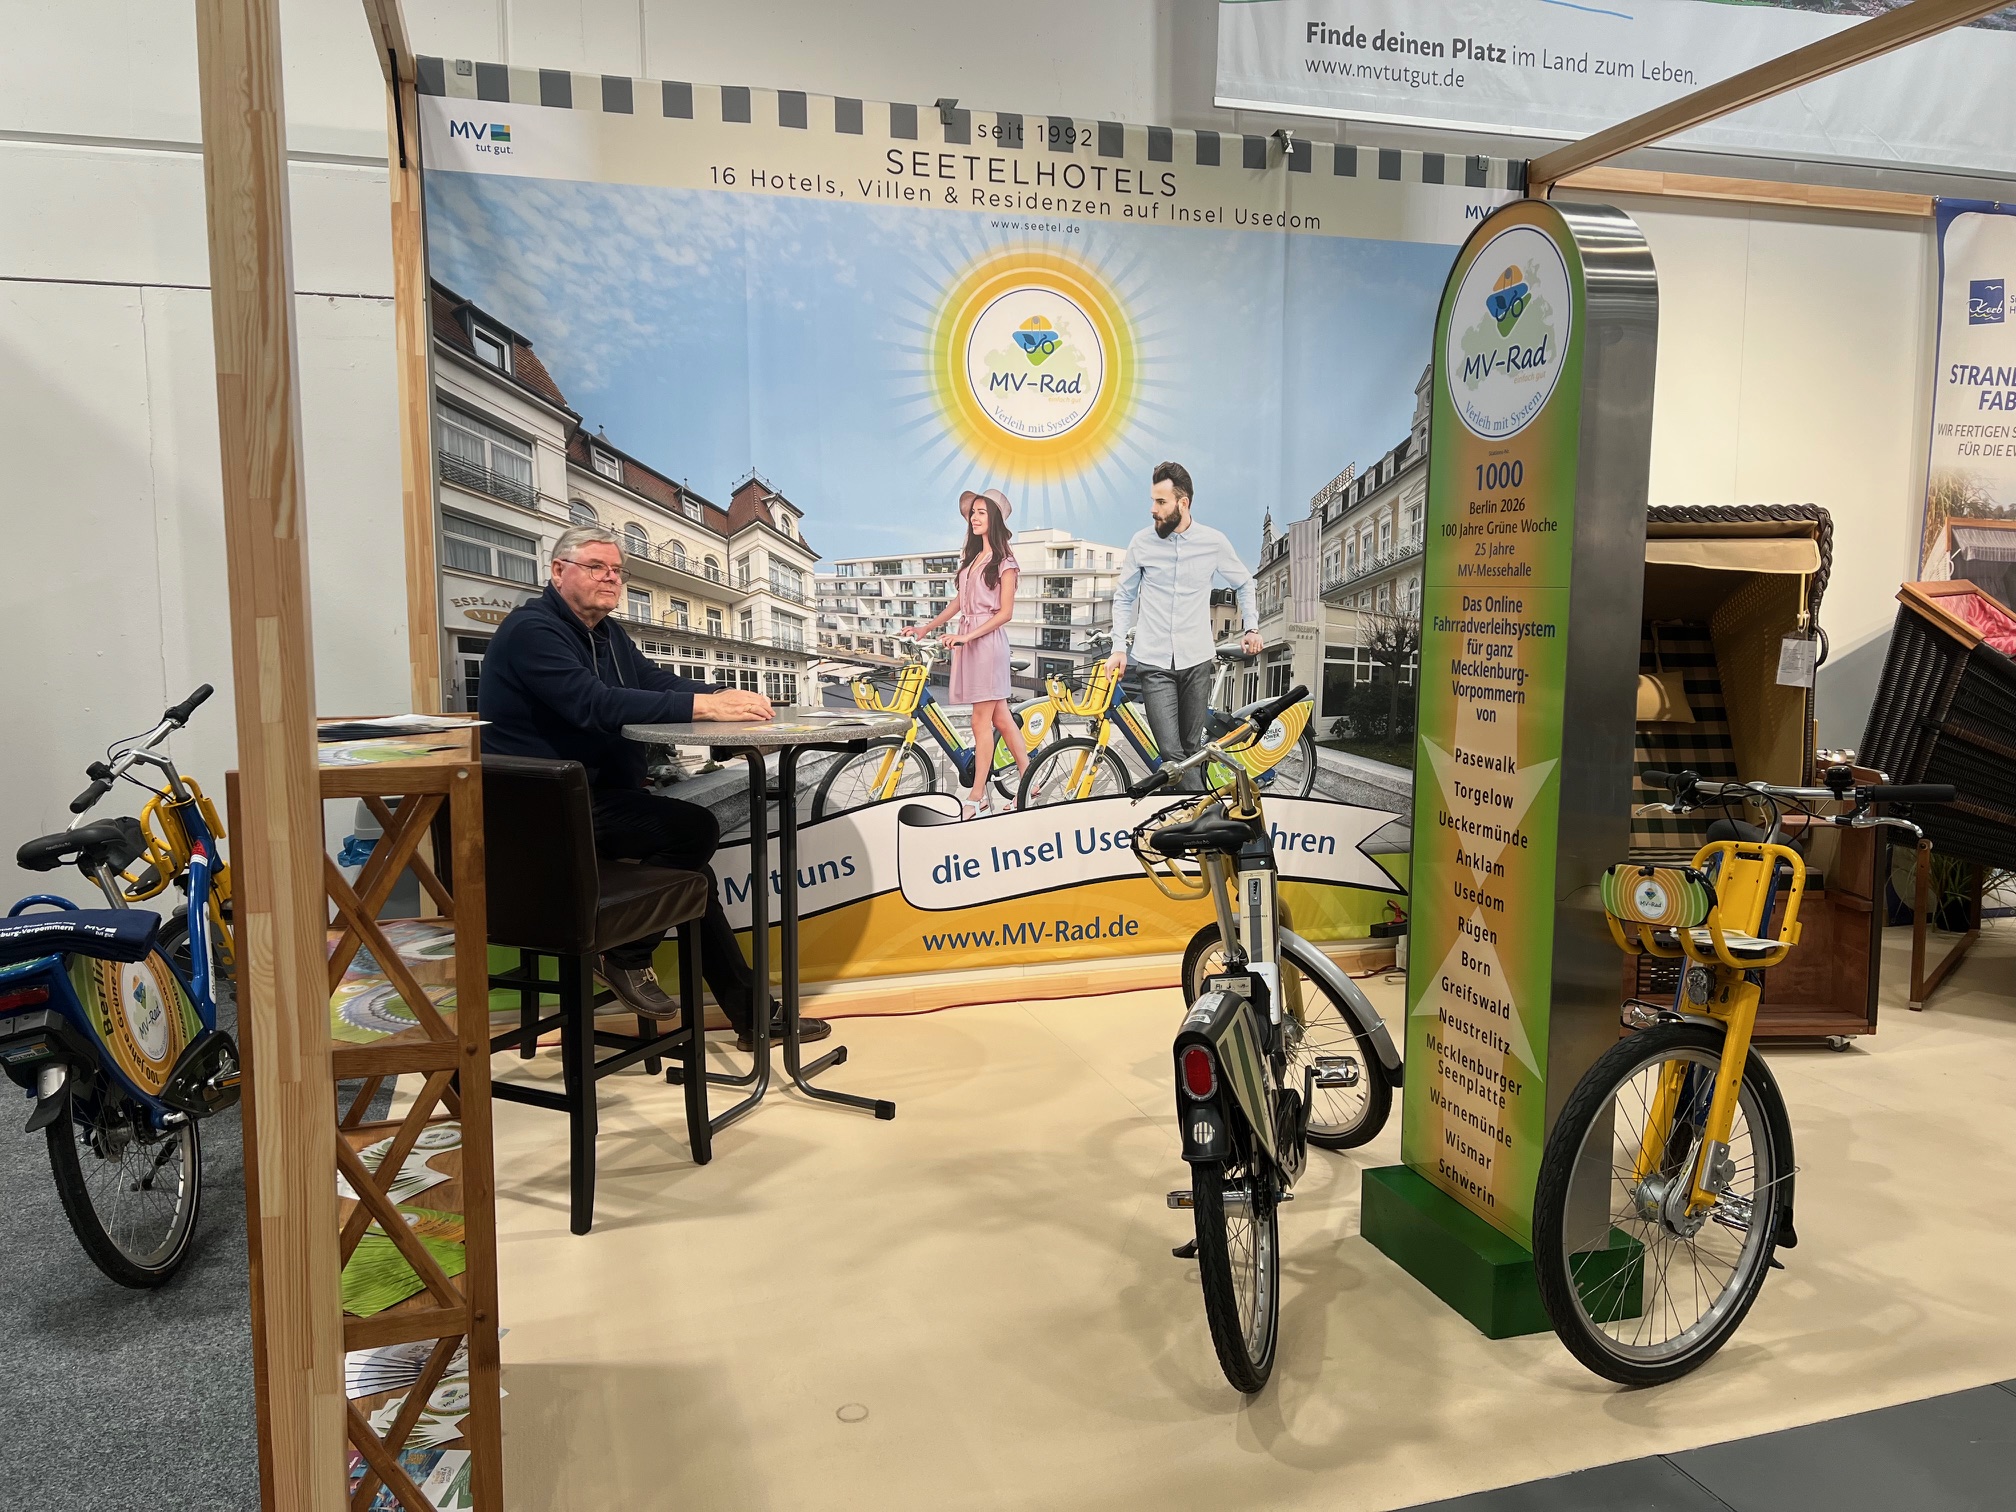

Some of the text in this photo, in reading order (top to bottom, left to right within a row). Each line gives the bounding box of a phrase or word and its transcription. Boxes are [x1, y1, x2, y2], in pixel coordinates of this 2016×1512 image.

[1306, 22, 1698, 85] Finde deinen Platz im Land zum Leben.
[1305, 59, 1465, 88] www.mvtutgut.de
[450, 119, 487, 140] MV
[977, 122, 1092, 147] seit 1992
[476, 144, 513, 155] tut gut.
[886, 149, 1176, 197] SEETELHOTELS
[710, 166, 1320, 230] 16 Hotels, Villen & Residenzen auf Insel Usedom
[1465, 205, 1491, 220] MV
[991, 220, 1080, 234] www.seetel.de
[1463, 333, 1547, 383] MV-Rad
[989, 372, 1082, 394] MV-Rad
[994, 405, 1079, 433] Verleih mit System
[1465, 391, 1542, 431] Verleih mit System
[1937, 423, 1953, 437] WIR
[1955, 424, 2010, 438] FERTIGEN
[1958, 441, 1980, 456] FÜR
[1983, 444, 2004, 456] DIE
[1476, 460, 1523, 491] 1000
[1469, 497, 1525, 515] Berlin 2026
[1441, 517, 1558, 539] 100 Jahre Grüne Woche
[1475, 541, 1515, 558] 25 Jahre
[1458, 562, 1532, 577] MV-Messehalle
[1462, 595, 1523, 613] Das Online
[1433, 616, 1556, 640] Fahrradverleihsystem
[1467, 638, 1513, 661] für ganz
[1451, 659, 1530, 686] Mecklenburg-
[1452, 680, 1525, 705] Vorpommern
[1476, 707, 1497, 723] von
[1455, 748, 1516, 775] Pasewalk
[1454, 781, 1514, 810] Torgelow
[1439, 810, 1528, 849] Ueckermünde
[932, 853, 980, 884] die
[991, 832, 1063, 872] Insel
[1456, 849, 1505, 878] Anklam
[724, 855, 855, 905] Mt uns
[1454, 882, 1505, 913] Usedom
[922, 914, 1139, 951] www.MV-Rad.de
[1458, 915, 1497, 945] Rügen
[1461, 950, 1491, 977] Born
[110, 976, 124, 1028] Grüne
[170, 977, 187, 1039] Schwerin
[1441, 976, 1510, 1020] Greifswald
[138, 1001, 162, 1039] MV-Rad
[1438, 1006, 1510, 1056] Neustrelitz
[124, 1033, 145, 1076] Jahre
[1426, 1032, 1522, 1096] Mecklenburger
[146, 1067, 160, 1085] 100
[1437, 1059, 1506, 1109] Seenplatte
[1429, 1086, 1512, 1148] Warnemünde
[1445, 1128, 1492, 1170] Wismar
[1438, 1158, 1495, 1208] Schwerin
[443, 1392, 468, 1408] MV-Ra
